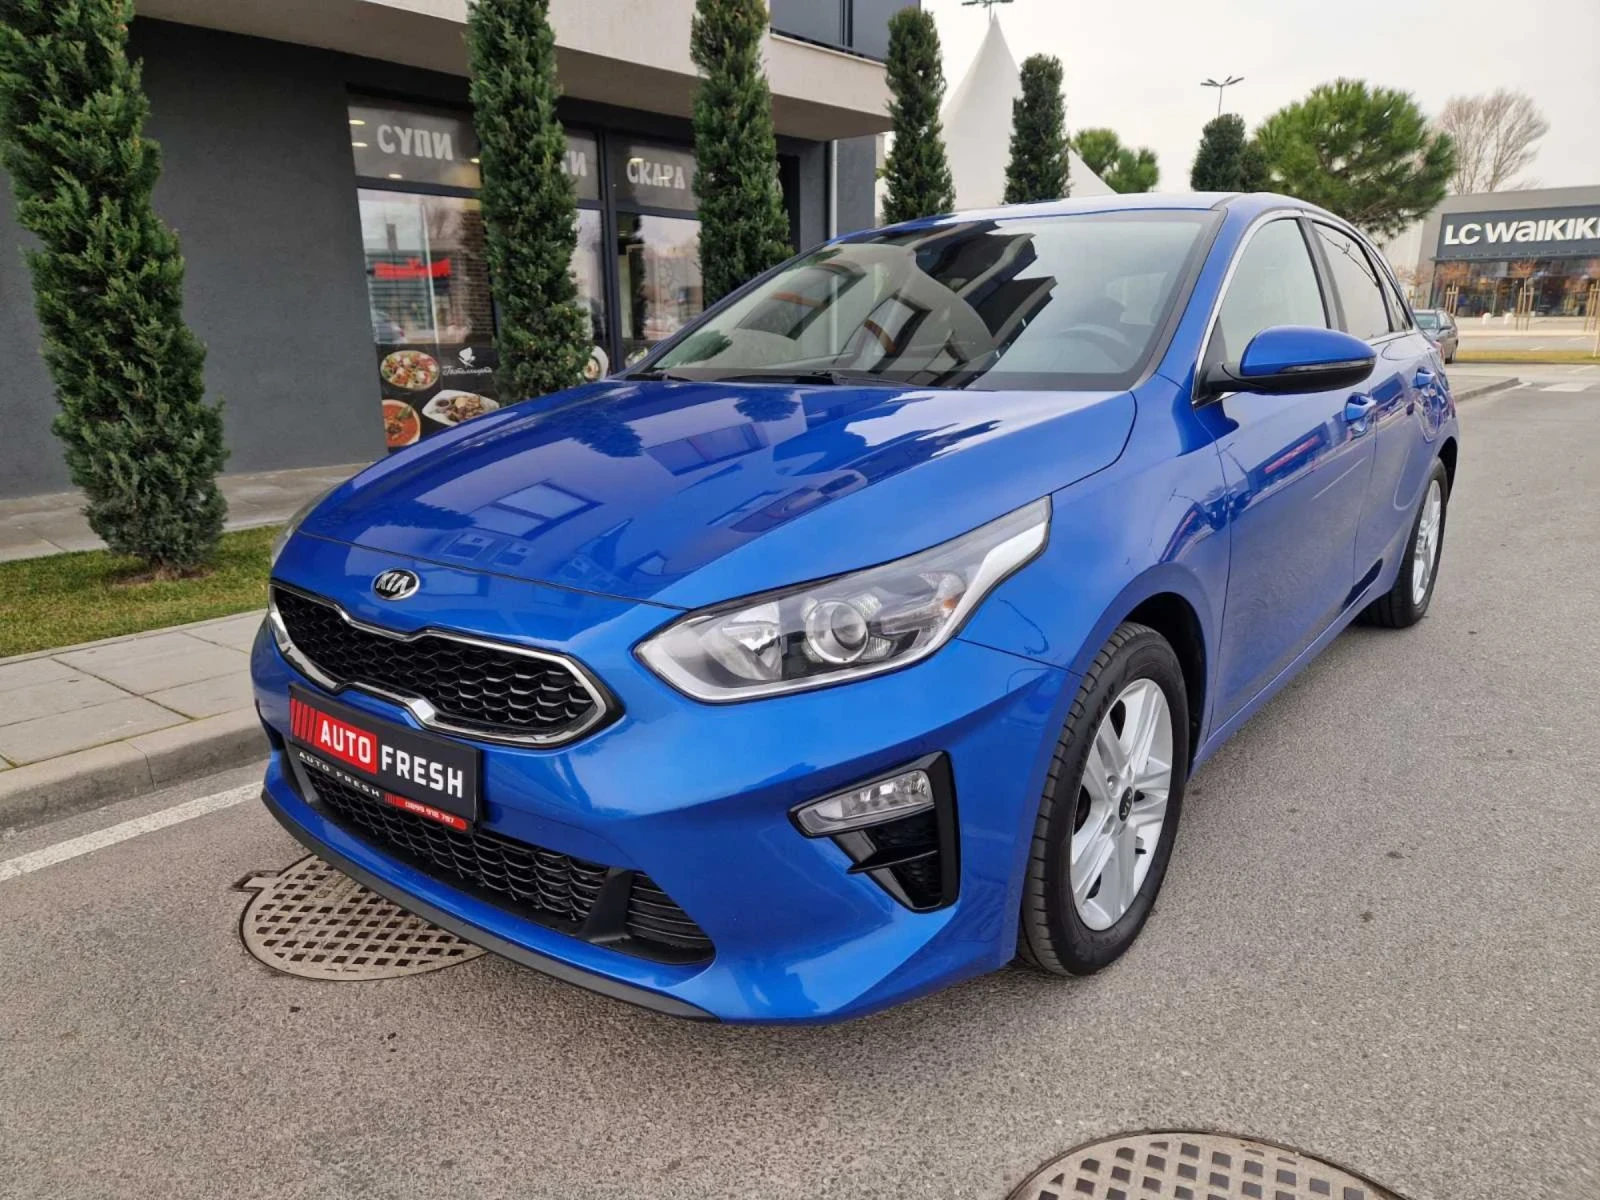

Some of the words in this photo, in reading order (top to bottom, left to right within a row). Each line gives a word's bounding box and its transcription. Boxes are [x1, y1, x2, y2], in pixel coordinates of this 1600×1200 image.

[377, 124, 453, 160] СУПИ
[627, 161, 685, 189] СКАРА
[1444, 223, 1482, 245] LC
[376, 573, 410, 594] KIA
[299, 751, 330, 771] AUTO
[336, 771, 380, 797] FRESH
[320, 720, 371, 764] AUTO
[381, 744, 463, 798] FRESH
